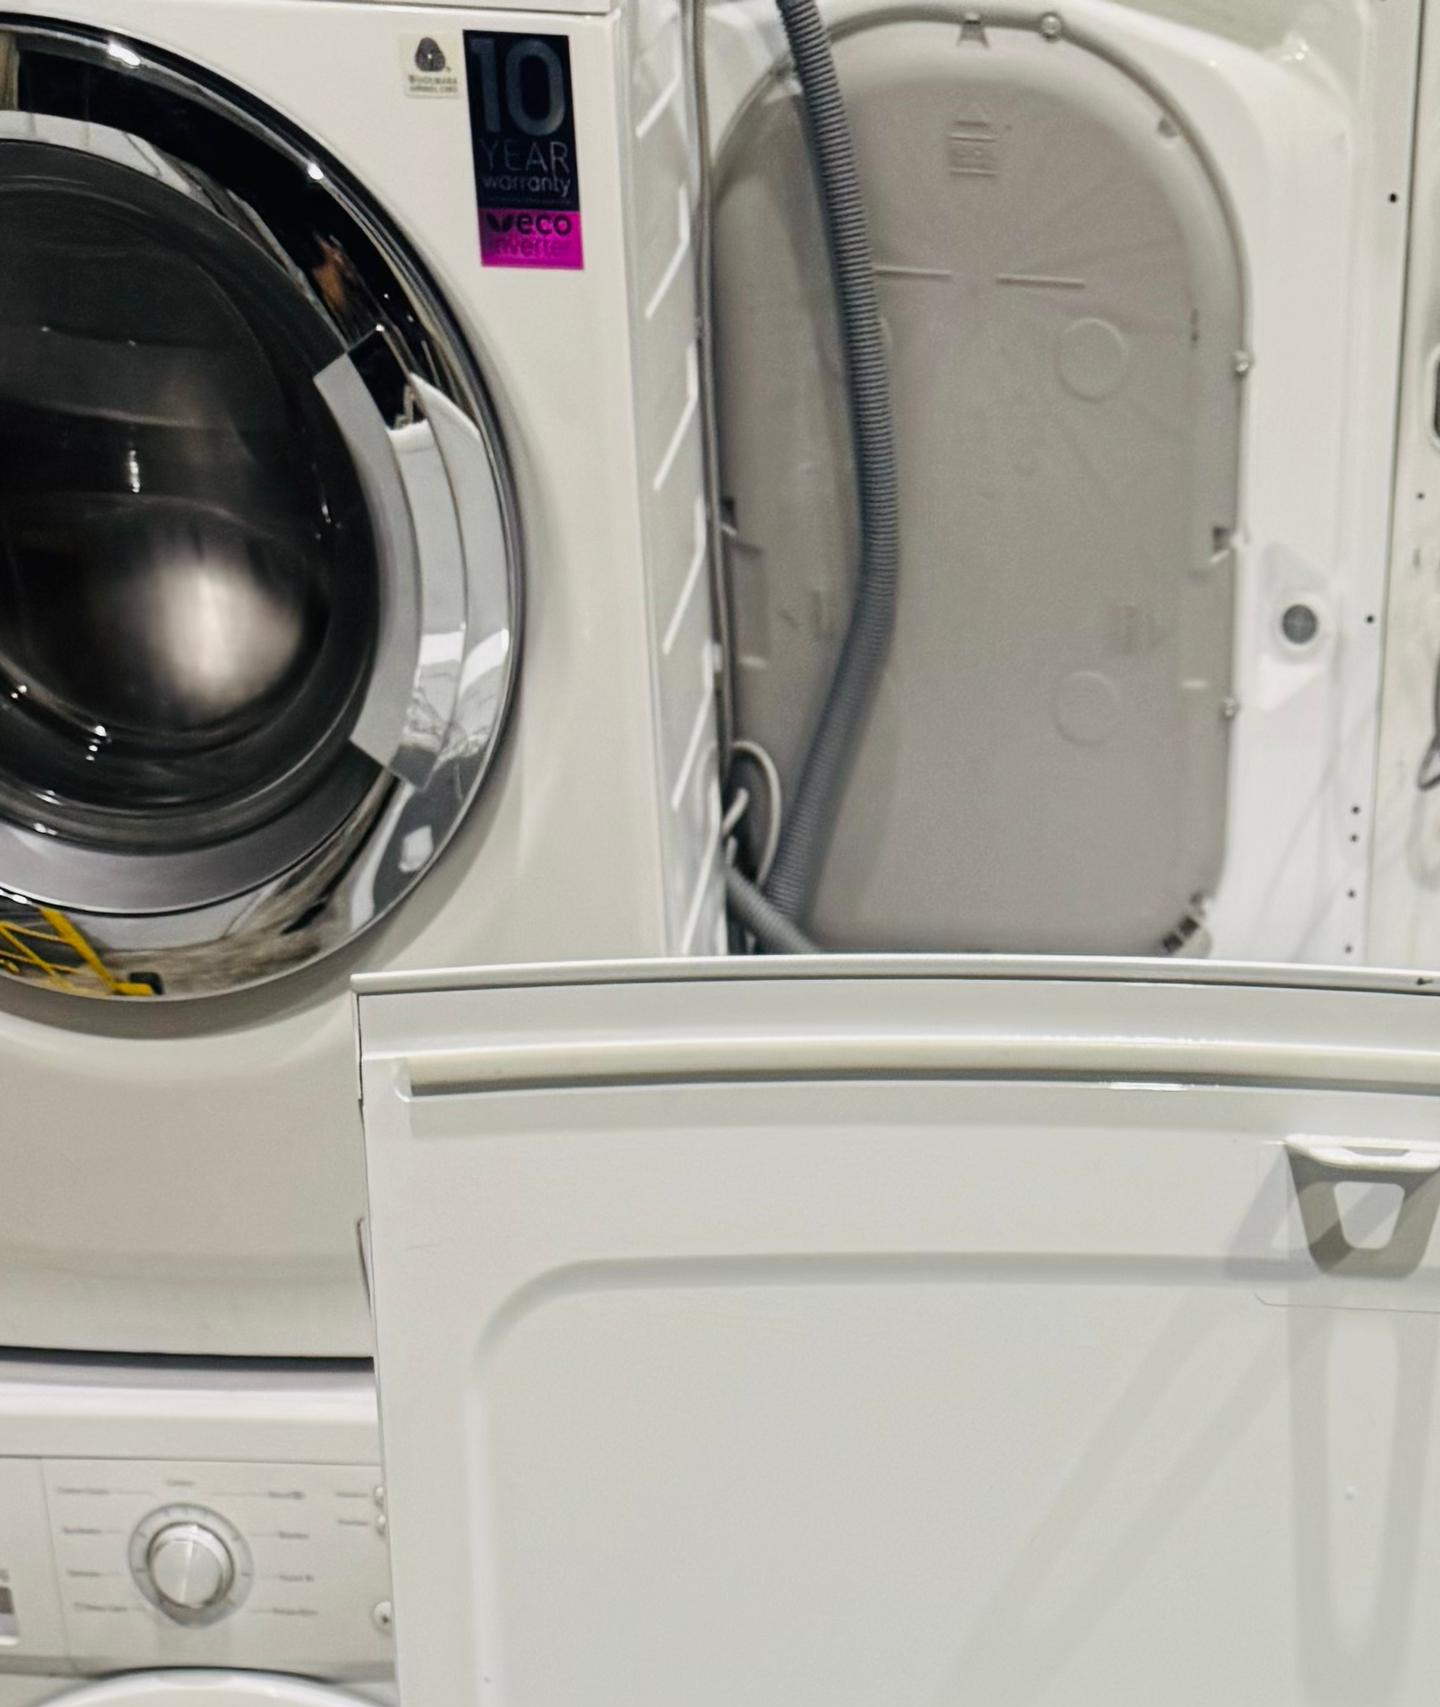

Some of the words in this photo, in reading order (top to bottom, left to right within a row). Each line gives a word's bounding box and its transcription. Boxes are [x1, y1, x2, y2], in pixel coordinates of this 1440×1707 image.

[470, 37, 566, 136] 10
[480, 139, 571, 174] YEAR
[482, 174, 571, 198] warranty
[516, 213, 573, 237] eco
